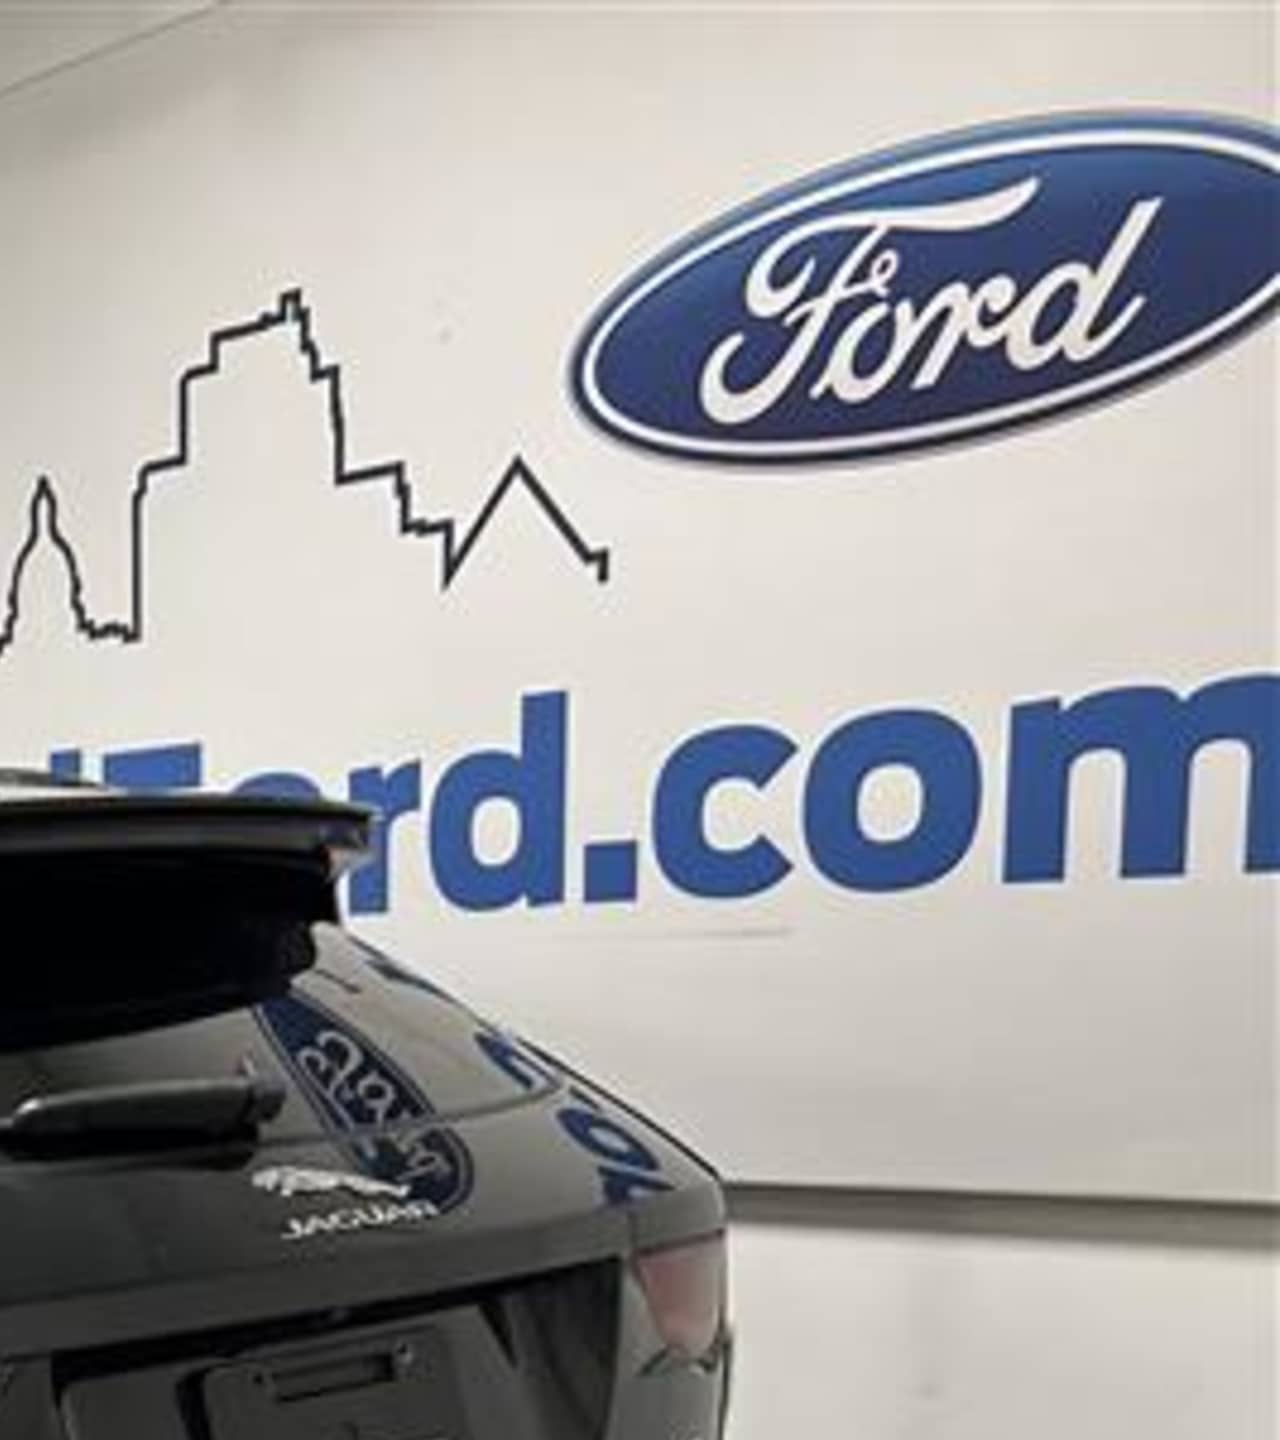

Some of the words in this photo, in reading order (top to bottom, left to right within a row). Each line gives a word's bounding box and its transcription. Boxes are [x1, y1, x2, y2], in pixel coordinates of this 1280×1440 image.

[699, 176, 1162, 425] Ford
[49, 672, 1280, 916] rd.com
[280, 1201, 440, 1239] JAGUAR
